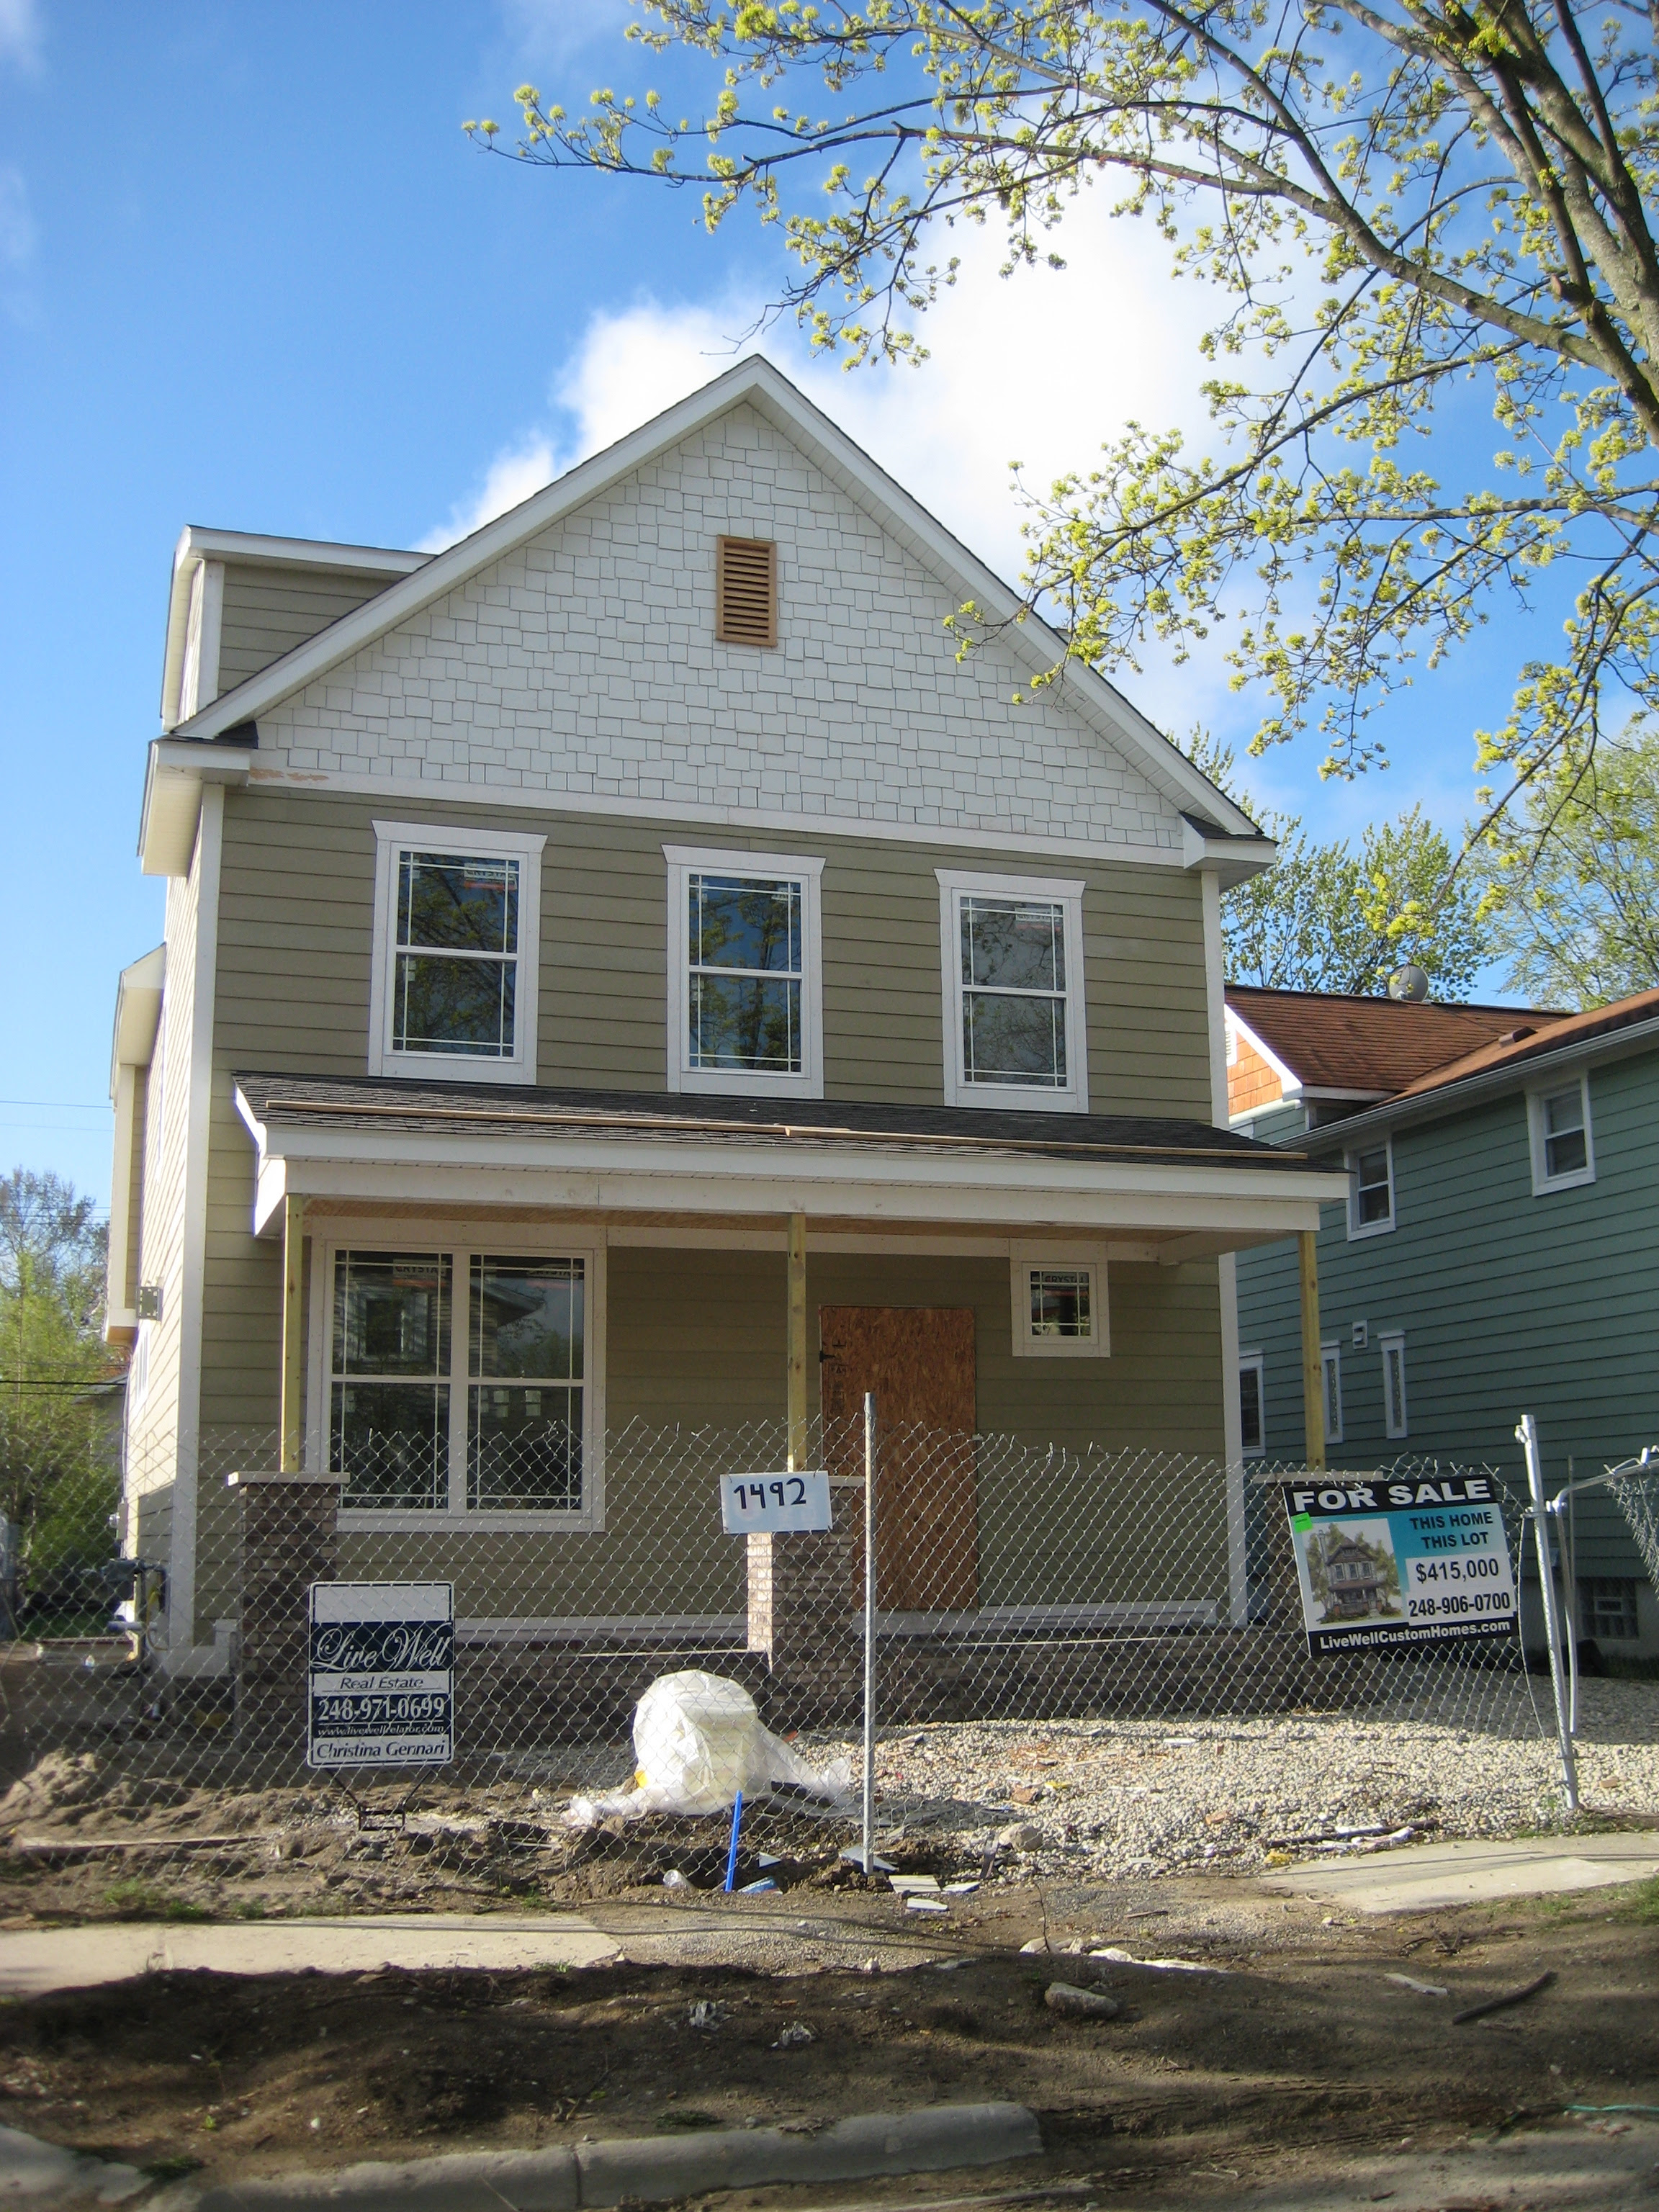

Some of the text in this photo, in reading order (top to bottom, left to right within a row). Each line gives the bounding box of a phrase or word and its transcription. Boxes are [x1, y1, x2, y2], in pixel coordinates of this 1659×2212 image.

[733, 1478, 806, 1509] 1492
[1292, 1479, 1491, 1511] FOR SALE
[1409, 1511, 1493, 1530] THIS HOME
[1421, 1532, 1488, 1550] THIS LOT
[1415, 1558, 1499, 1584] $415,000
[1408, 1592, 1511, 1617] 248-906-0700
[310, 1622, 452, 1671] Live Well
[1319, 1621, 1511, 1650] LiveWellCustomHomes.com
[340, 1676, 423, 1689] Real Estate
[318, 1697, 445, 1721] 248-971-0699
[317, 1743, 381, 1758] Christina
